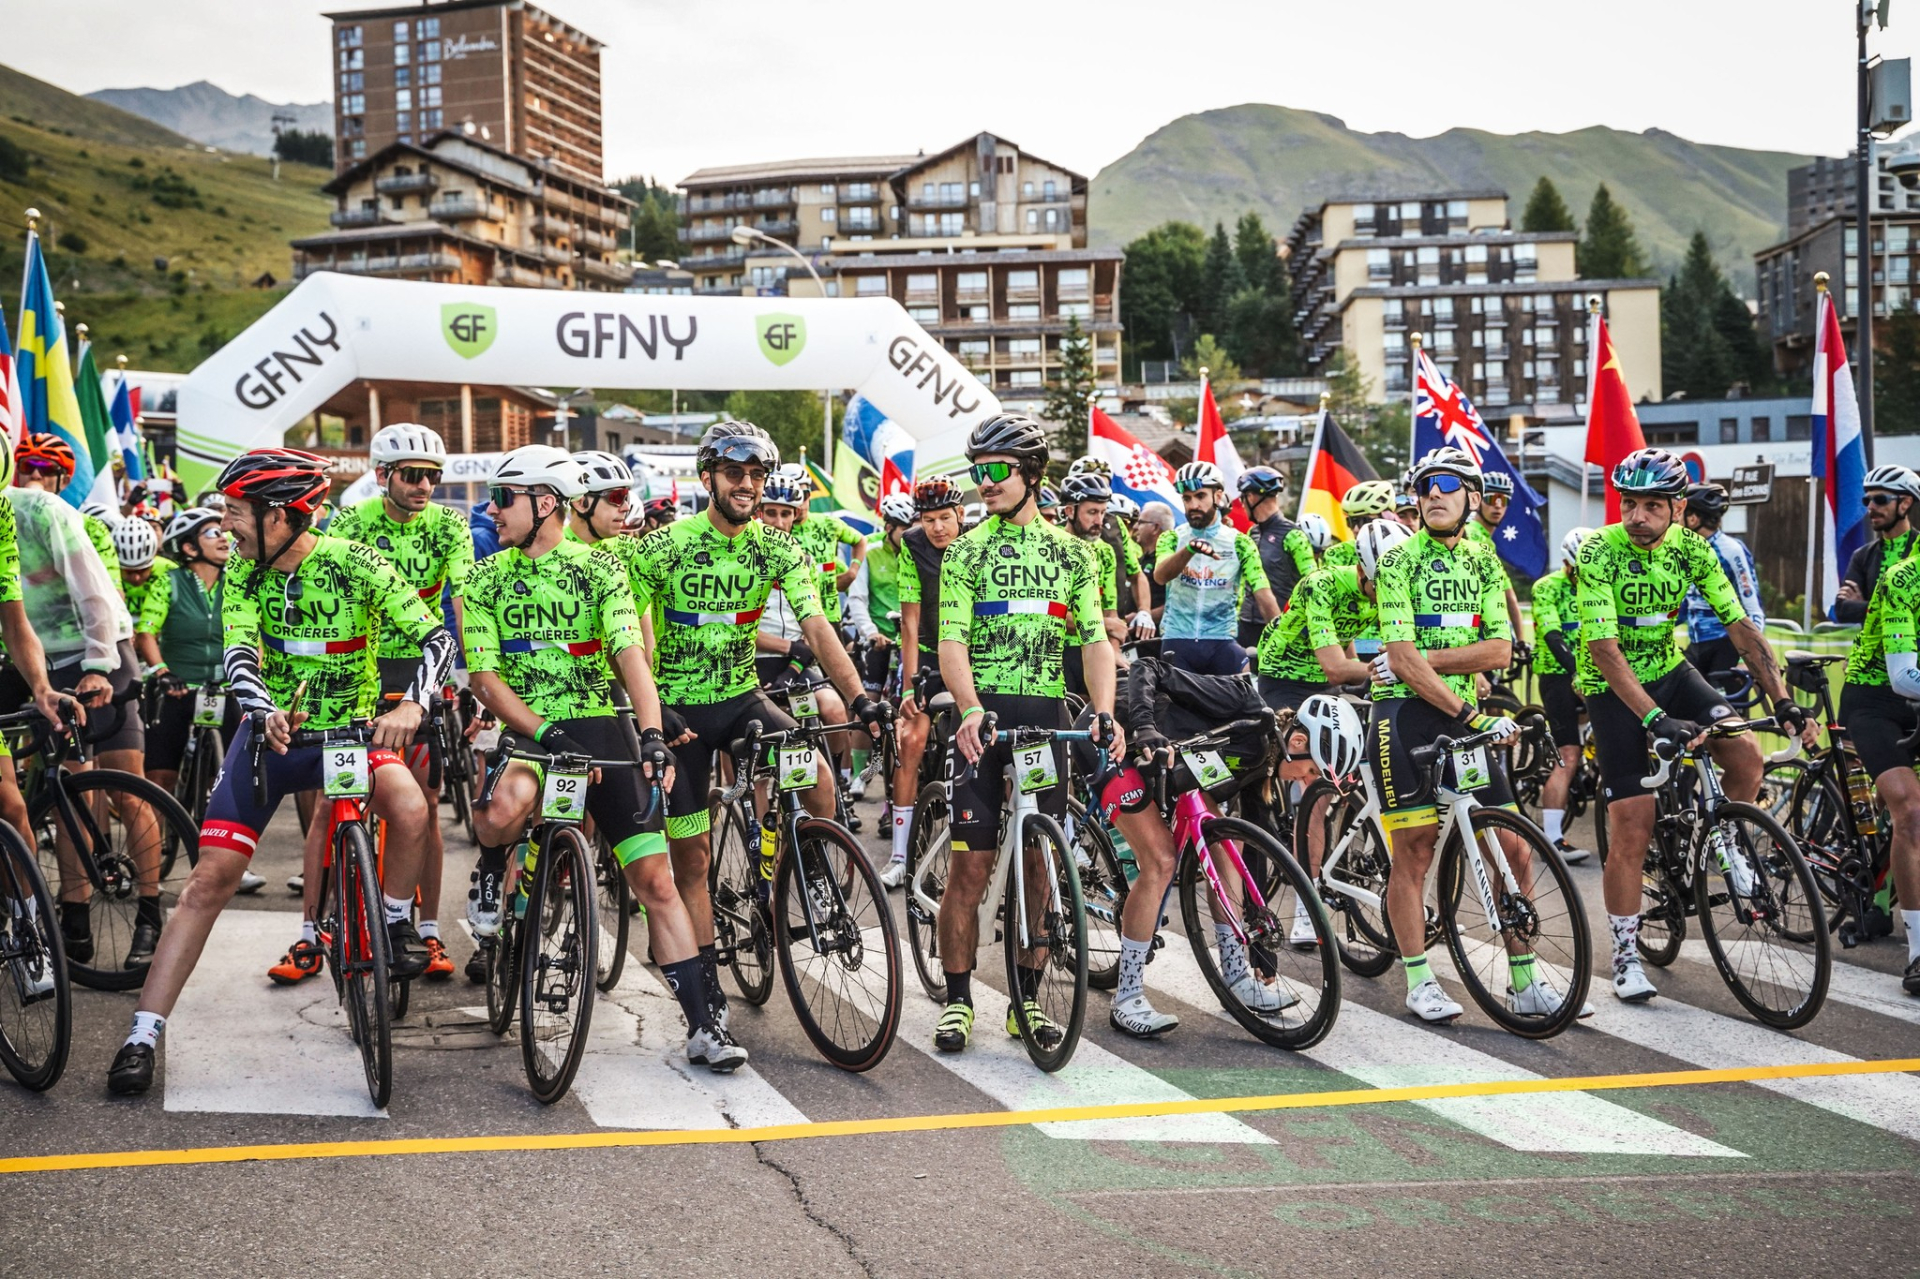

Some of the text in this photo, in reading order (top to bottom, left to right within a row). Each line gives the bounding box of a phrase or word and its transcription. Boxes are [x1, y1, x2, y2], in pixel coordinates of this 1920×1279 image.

[556, 311, 697, 361] GFNY
[235, 311, 341, 409] GFNY
[888, 335, 981, 419] GFNY
[637, 526, 671, 555] GFNY
[644, 538, 675, 561] ORCIÈRES
[1580, 532, 1603, 565] GFNY
[345, 554, 379, 575] ORCIÈRES
[1892, 562, 1917, 589] GFNY
[679, 572, 755, 599] GFNY
[991, 564, 1060, 588] GFNY
[998, 586, 1059, 600] ORCIÈRES
[1425, 579, 1480, 601] GFNY
[1620, 579, 1683, 606] GFNY
[266, 597, 340, 626] GNY
[503, 600, 580, 629] GFNY
[687, 598, 749, 612] ORCIÈRES
[1431, 600, 1480, 613] ORCIÈRES
[1625, 602, 1681, 615] ORCIÈRES
[271, 624, 340, 639] ORCIÈRES
[513, 626, 580, 641] ORCIÈRES
[203, 697, 218, 708] 35
[1331, 705, 1341, 731] KASK
[334, 752, 356, 767] 34
[785, 751, 812, 766] 110
[1024, 750, 1042, 766] 57
[1195, 753, 1206, 764] 3
[1378, 718, 1398, 809] MANDELIEU
[1461, 752, 1477, 766] 31
[556, 778, 577, 793] 92
[1474, 858, 1496, 919] CANYON
